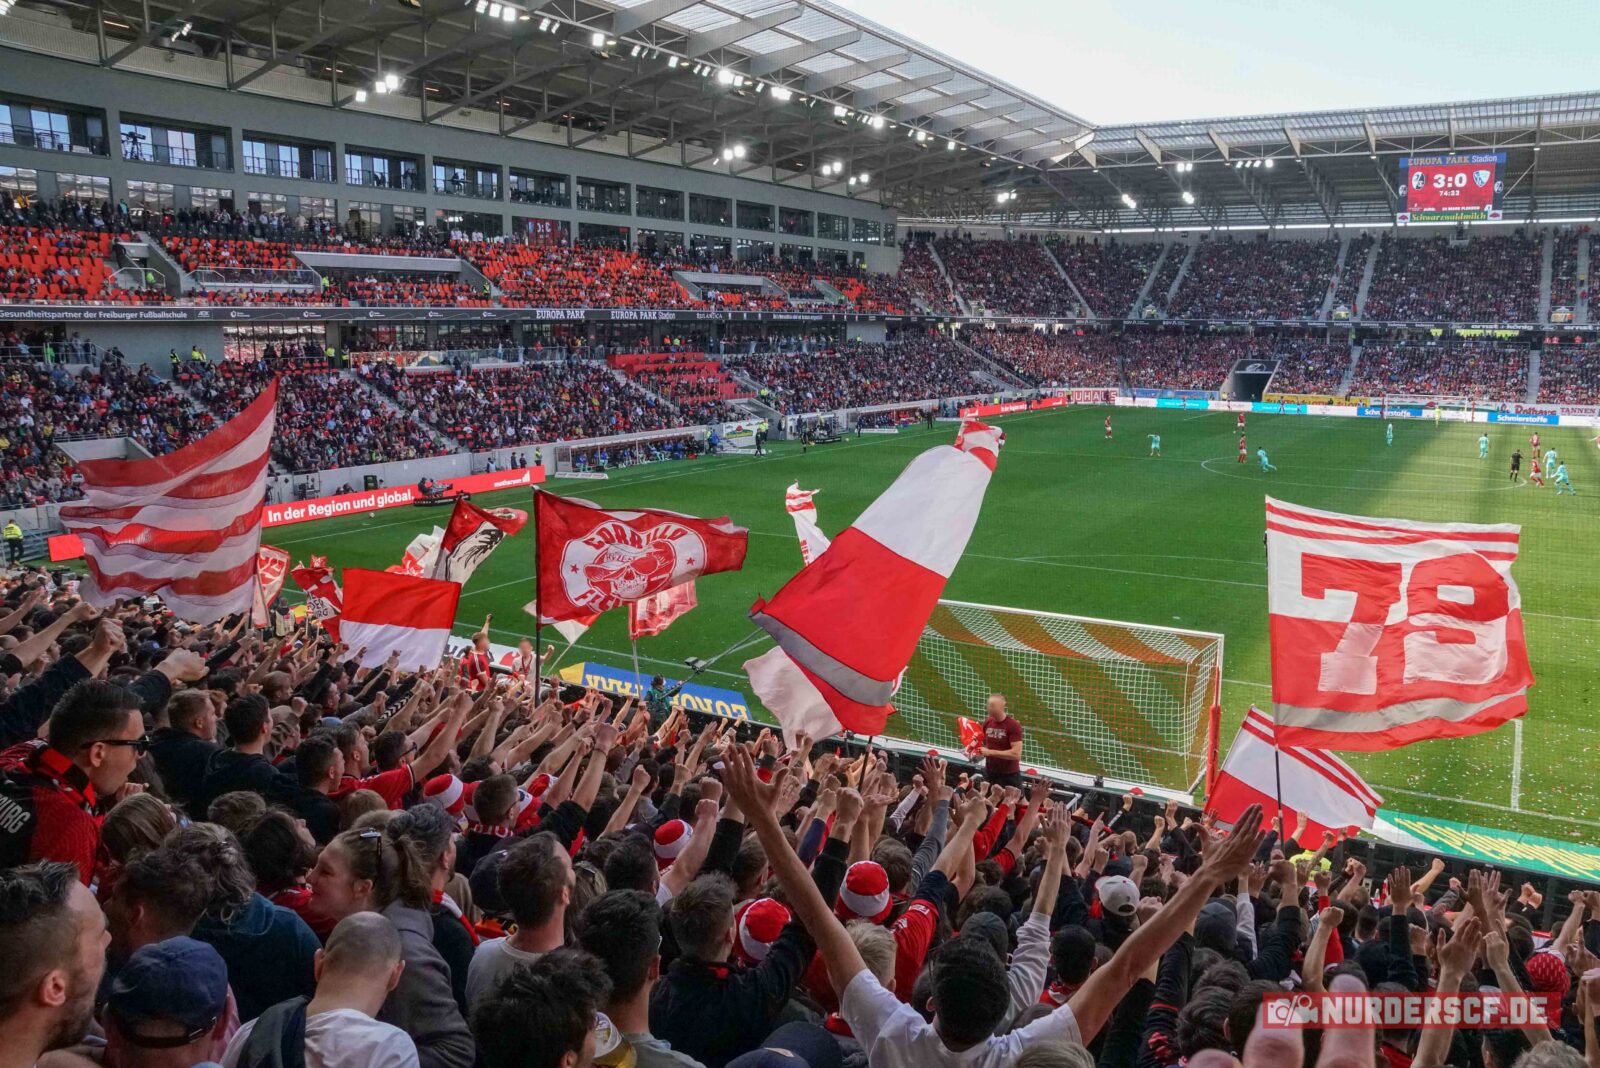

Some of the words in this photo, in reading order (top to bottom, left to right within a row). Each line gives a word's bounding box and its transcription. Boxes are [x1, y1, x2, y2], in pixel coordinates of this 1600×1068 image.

[1408, 157, 1442, 166] EUROPA
[1446, 155, 1469, 164] PARK
[1471, 154, 1498, 163] Stadion
[1433, 173, 1467, 188] 3:0
[1412, 212, 1486, 222] Schwarzwaldmilch
[0, 309, 82, 320] Gesundheitspartner
[83, 310, 97, 319] der
[98, 311, 138, 320] Freiburger
[139, 311, 187, 319] Fußballschule
[536, 310, 565, 319] EUROPA
[566, 310, 585, 319] PARK
[611, 311, 638, 320] EUROPA
[639, 311, 657, 320] PARK
[658, 311, 676, 320] Stadion
[1057, 391, 1117, 402] BUHAS
[1364, 406, 1411, 416] Schmerstoffe
[1497, 414, 1548, 423] Schmierstoffe
[267, 510, 282, 523] In
[284, 507, 305, 520] der
[308, 500, 351, 517] Region
[352, 495, 375, 509] und
[377, 489, 415, 507] global.
[582, 523, 688, 550] CORRILLO
